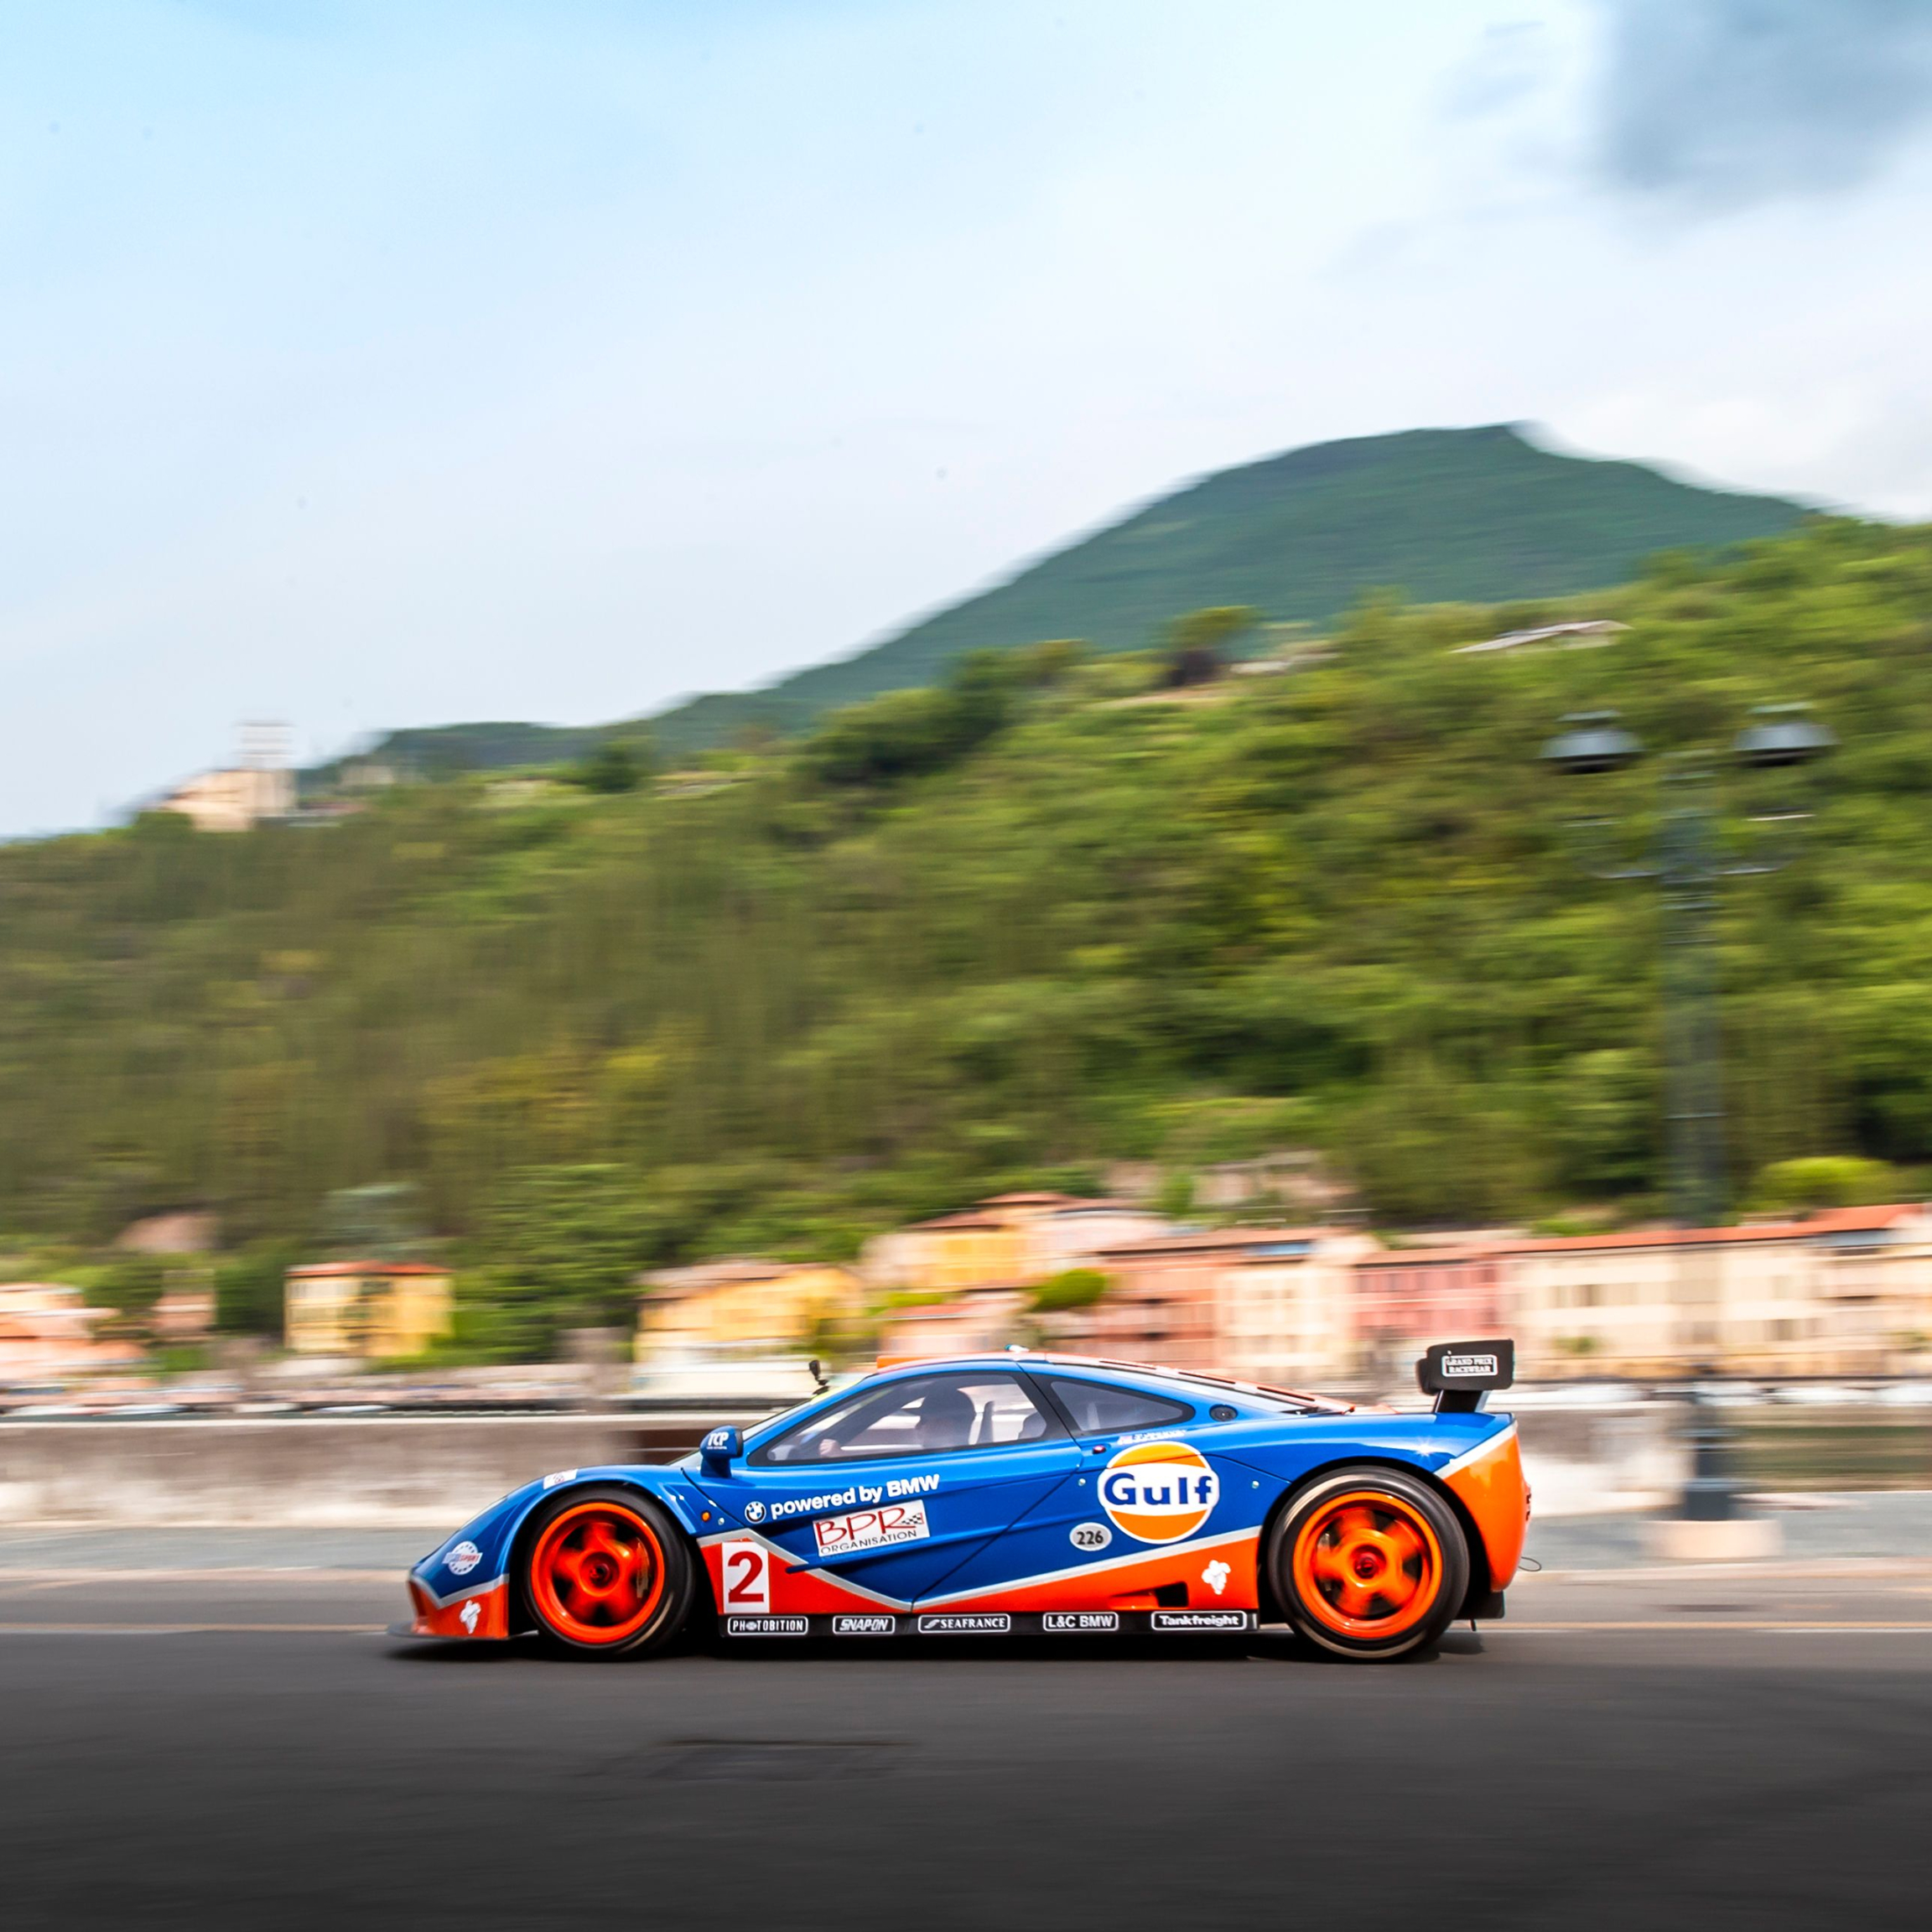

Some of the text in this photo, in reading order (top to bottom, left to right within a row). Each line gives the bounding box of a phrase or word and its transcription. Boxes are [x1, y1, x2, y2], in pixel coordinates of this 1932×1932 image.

[708, 1431, 729, 1446] TCP
[771, 1473, 940, 1519] powered by BMW
[1104, 1472, 1213, 1506] Gulf
[815, 1507, 917, 1546] BPR
[820, 1530, 917, 1555] ORGANISATION
[1076, 1531, 1104, 1545] 226
[728, 1550, 764, 1603] 2
[940, 1617, 1005, 1628] SEAFRANCE
[1047, 1615, 1113, 1628] L&C BMW
[1159, 1614, 1239, 1627] Tankfreight
